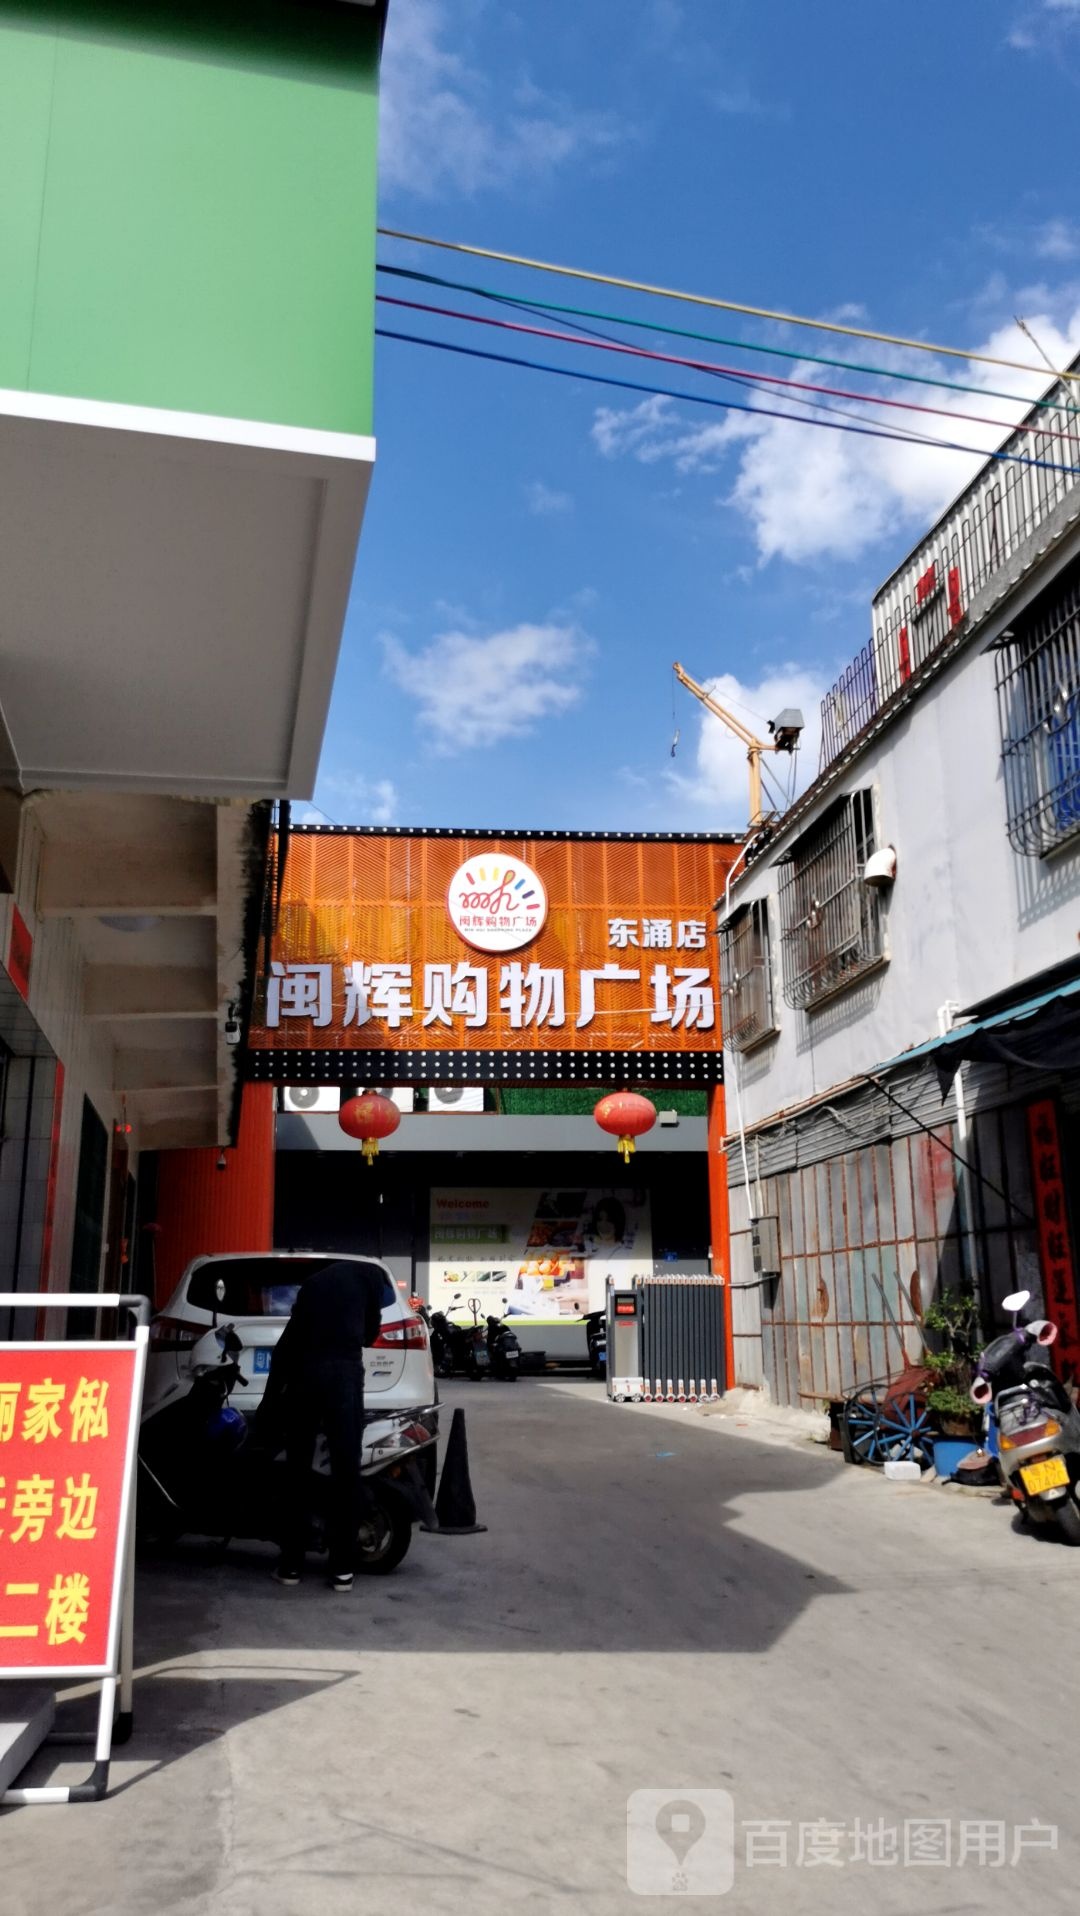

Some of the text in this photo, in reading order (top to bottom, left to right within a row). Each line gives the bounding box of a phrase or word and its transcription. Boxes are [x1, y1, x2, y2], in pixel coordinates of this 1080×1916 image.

[459, 915, 537, 927] 闽辉购物广场
[608, 917, 707, 949] 东涌店
[266, 960, 716, 1029] 闽辉购物广场
[436, 1199, 490, 1209] Welcome
[0, 1473, 99, 1544] 旁边
[0, 1572, 90, 1646] 二楼
